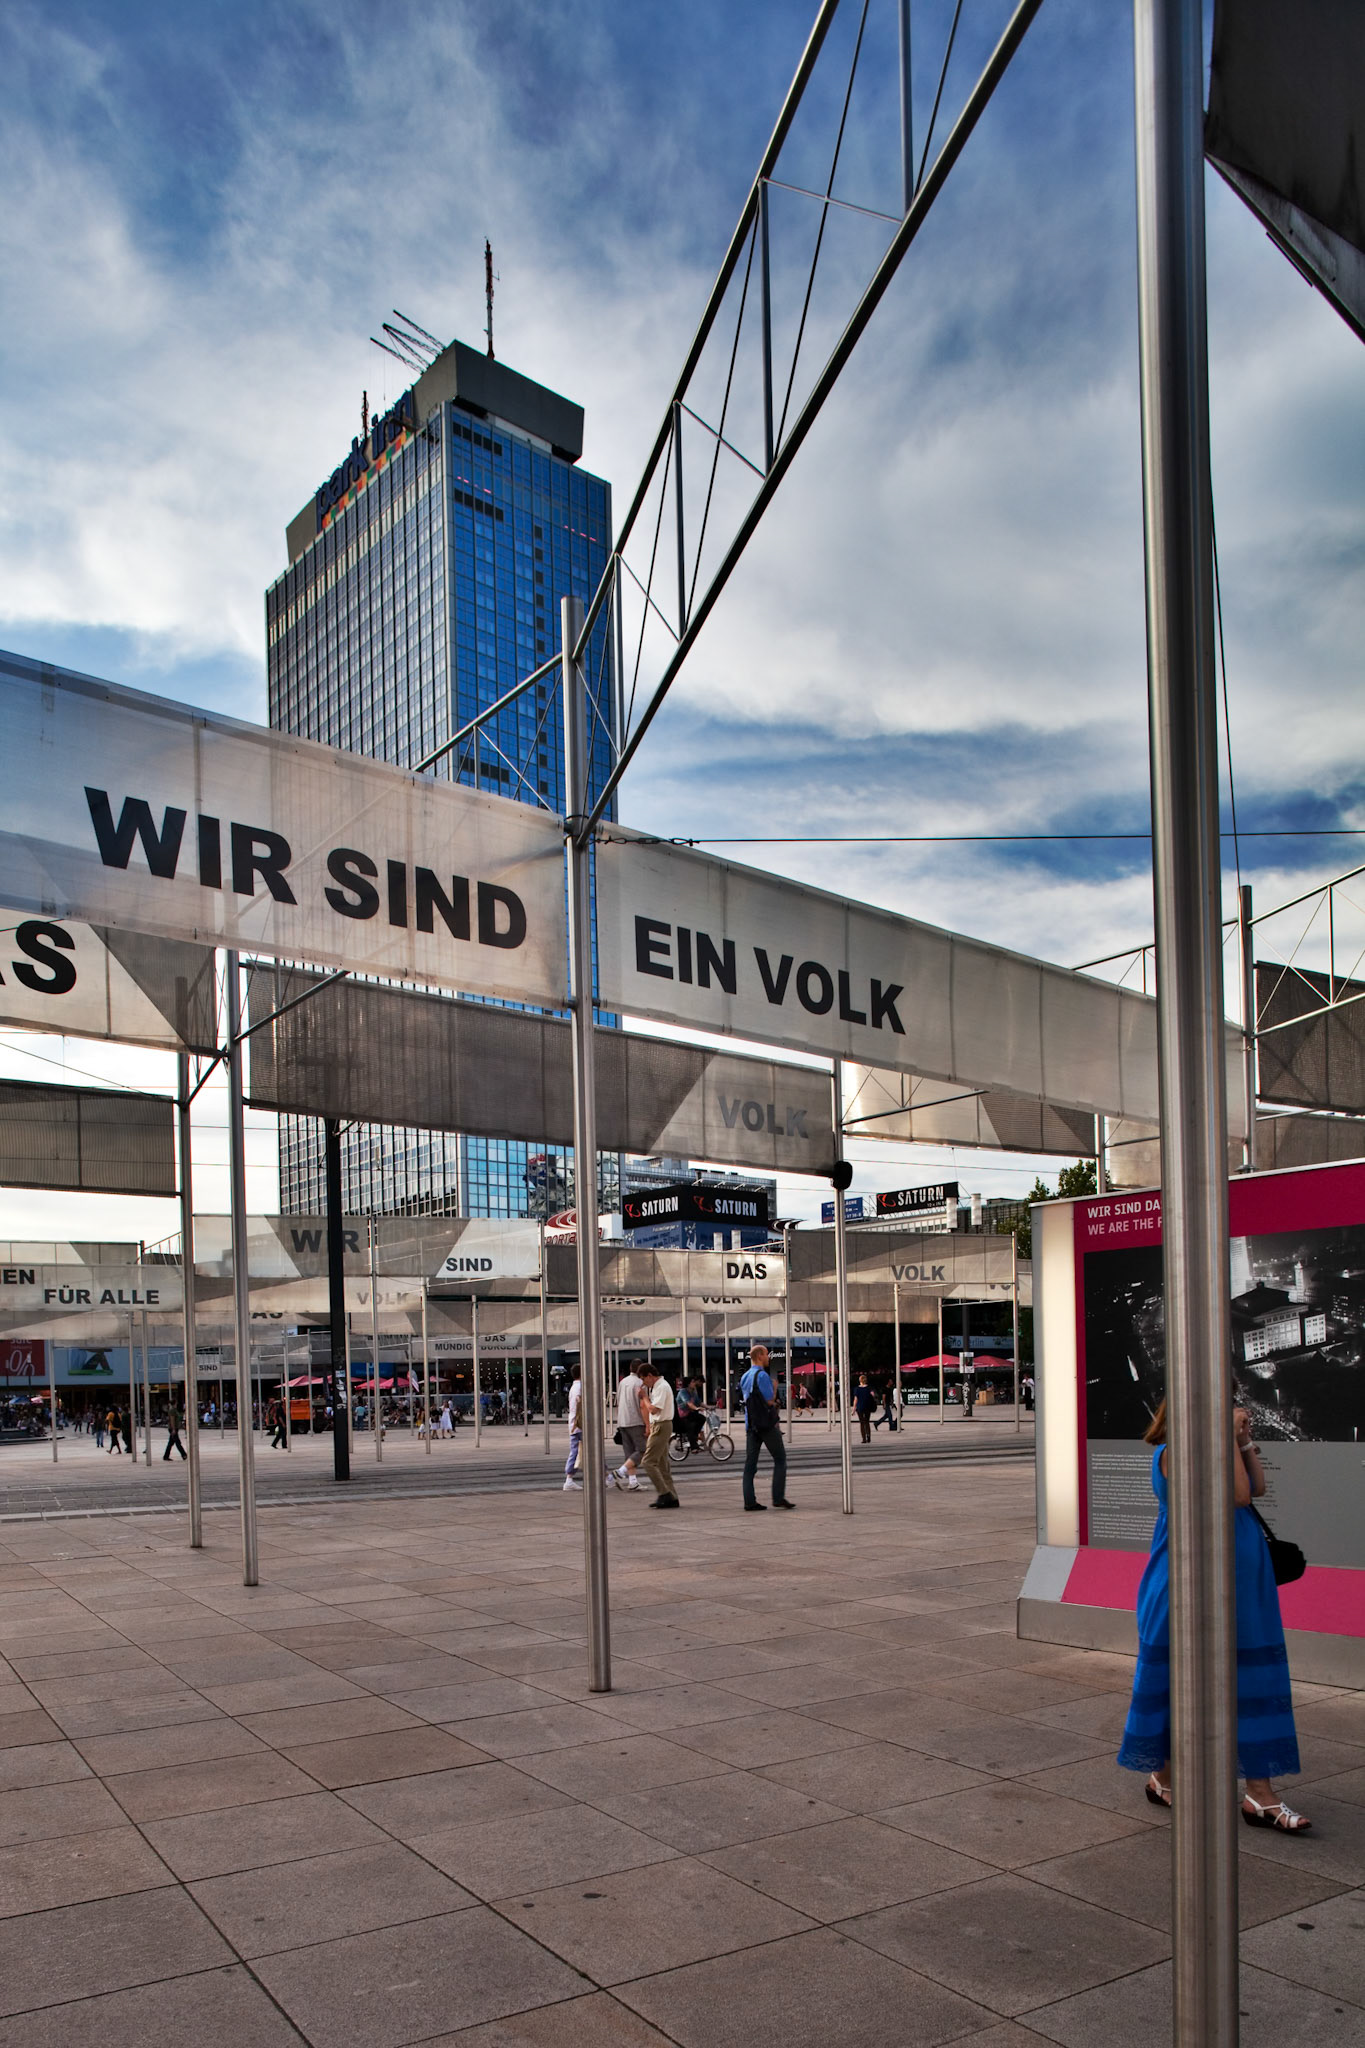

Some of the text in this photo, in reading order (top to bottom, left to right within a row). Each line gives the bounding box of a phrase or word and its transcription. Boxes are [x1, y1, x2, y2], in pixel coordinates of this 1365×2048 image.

[315, 435, 368, 534] park
[84, 786, 527, 949] WIR SIND
[0, 921, 77, 994] S
[634, 915, 906, 1035] EIN VOLK
[718, 1095, 809, 1139] VOLK
[897, 1185, 944, 1206] SATURN
[641, 1196, 757, 1217] SATURN SATURN
[1087, 1199, 1161, 1218] WIR SIND DA
[1087, 1223, 1105, 1236] WE
[1108, 1220, 1129, 1233] ARE
[1132, 1217, 1154, 1230] THE
[290, 1228, 360, 1253] WR
[446, 1257, 493, 1272] SIND
[726, 1262, 767, 1280] DAS
[891, 1265, 945, 1281] VOLK
[0, 1269, 35, 1285] EN
[44, 1285, 160, 1304] FÜR ALLE
[794, 1321, 823, 1333] SIND
